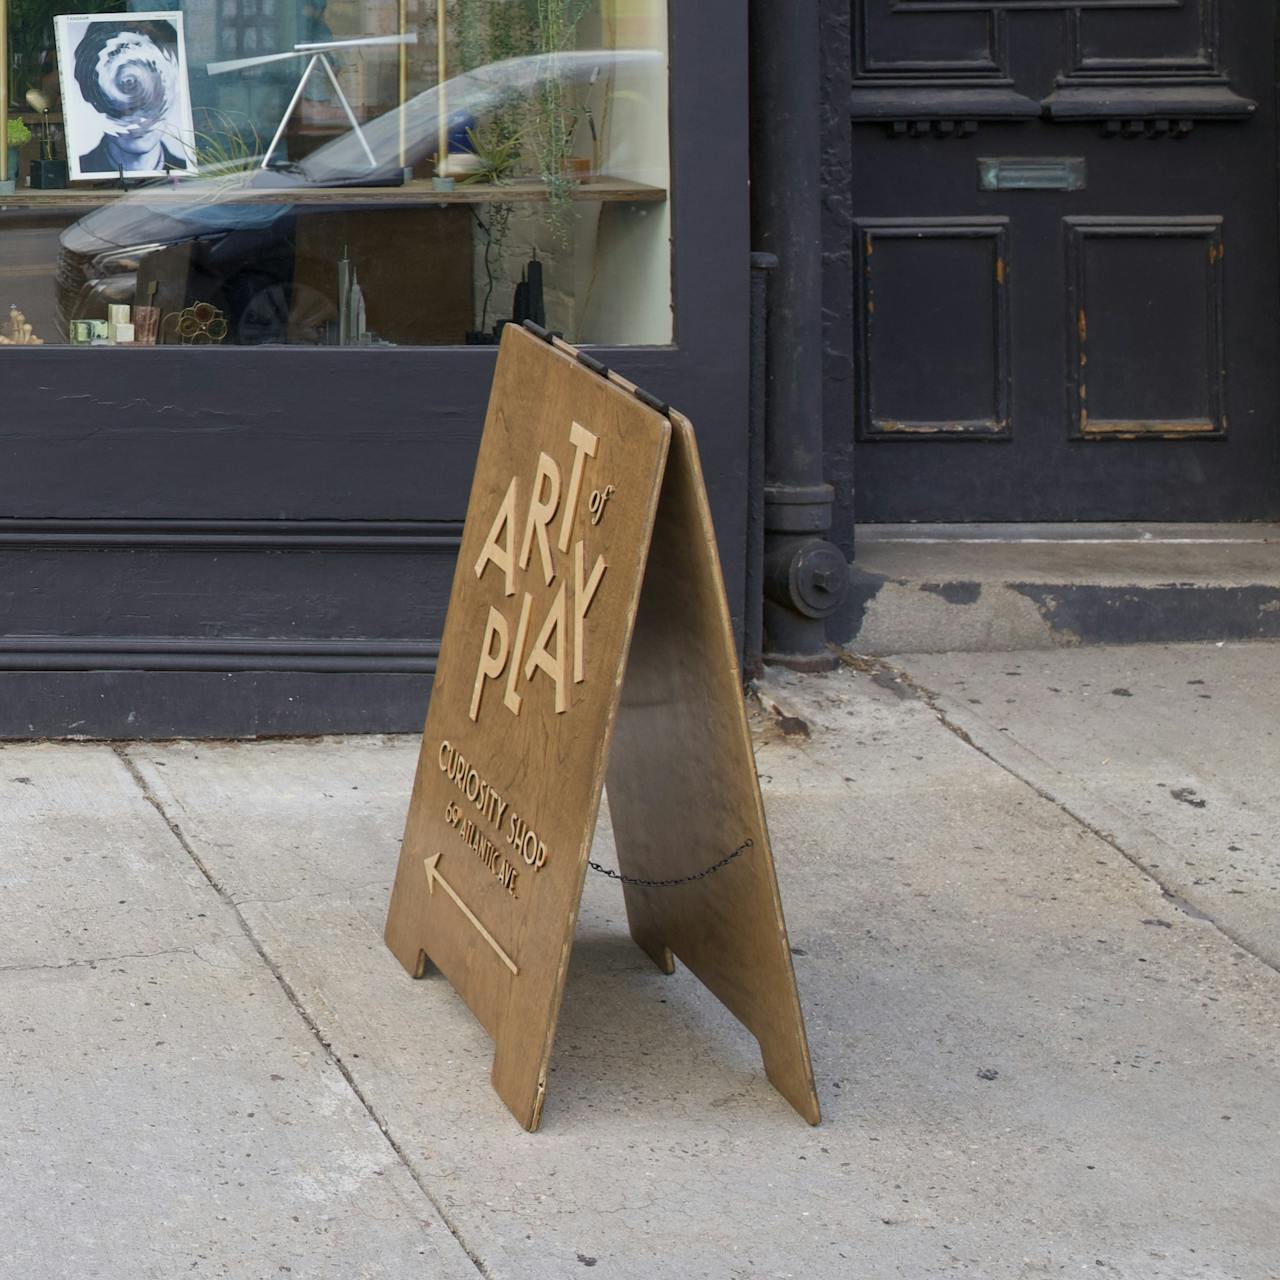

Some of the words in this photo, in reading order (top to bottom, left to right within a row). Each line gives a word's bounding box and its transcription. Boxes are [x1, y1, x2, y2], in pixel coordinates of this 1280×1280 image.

[473, 420, 602, 599] ART
[586, 482, 616, 524] of
[468, 540, 609, 723] PLAY
[438, 739, 509, 830] CURIOSITY
[505, 811, 550, 873] SHOP
[444, 800, 463, 829] 69
[458, 816, 501, 877] ATLANTIC
